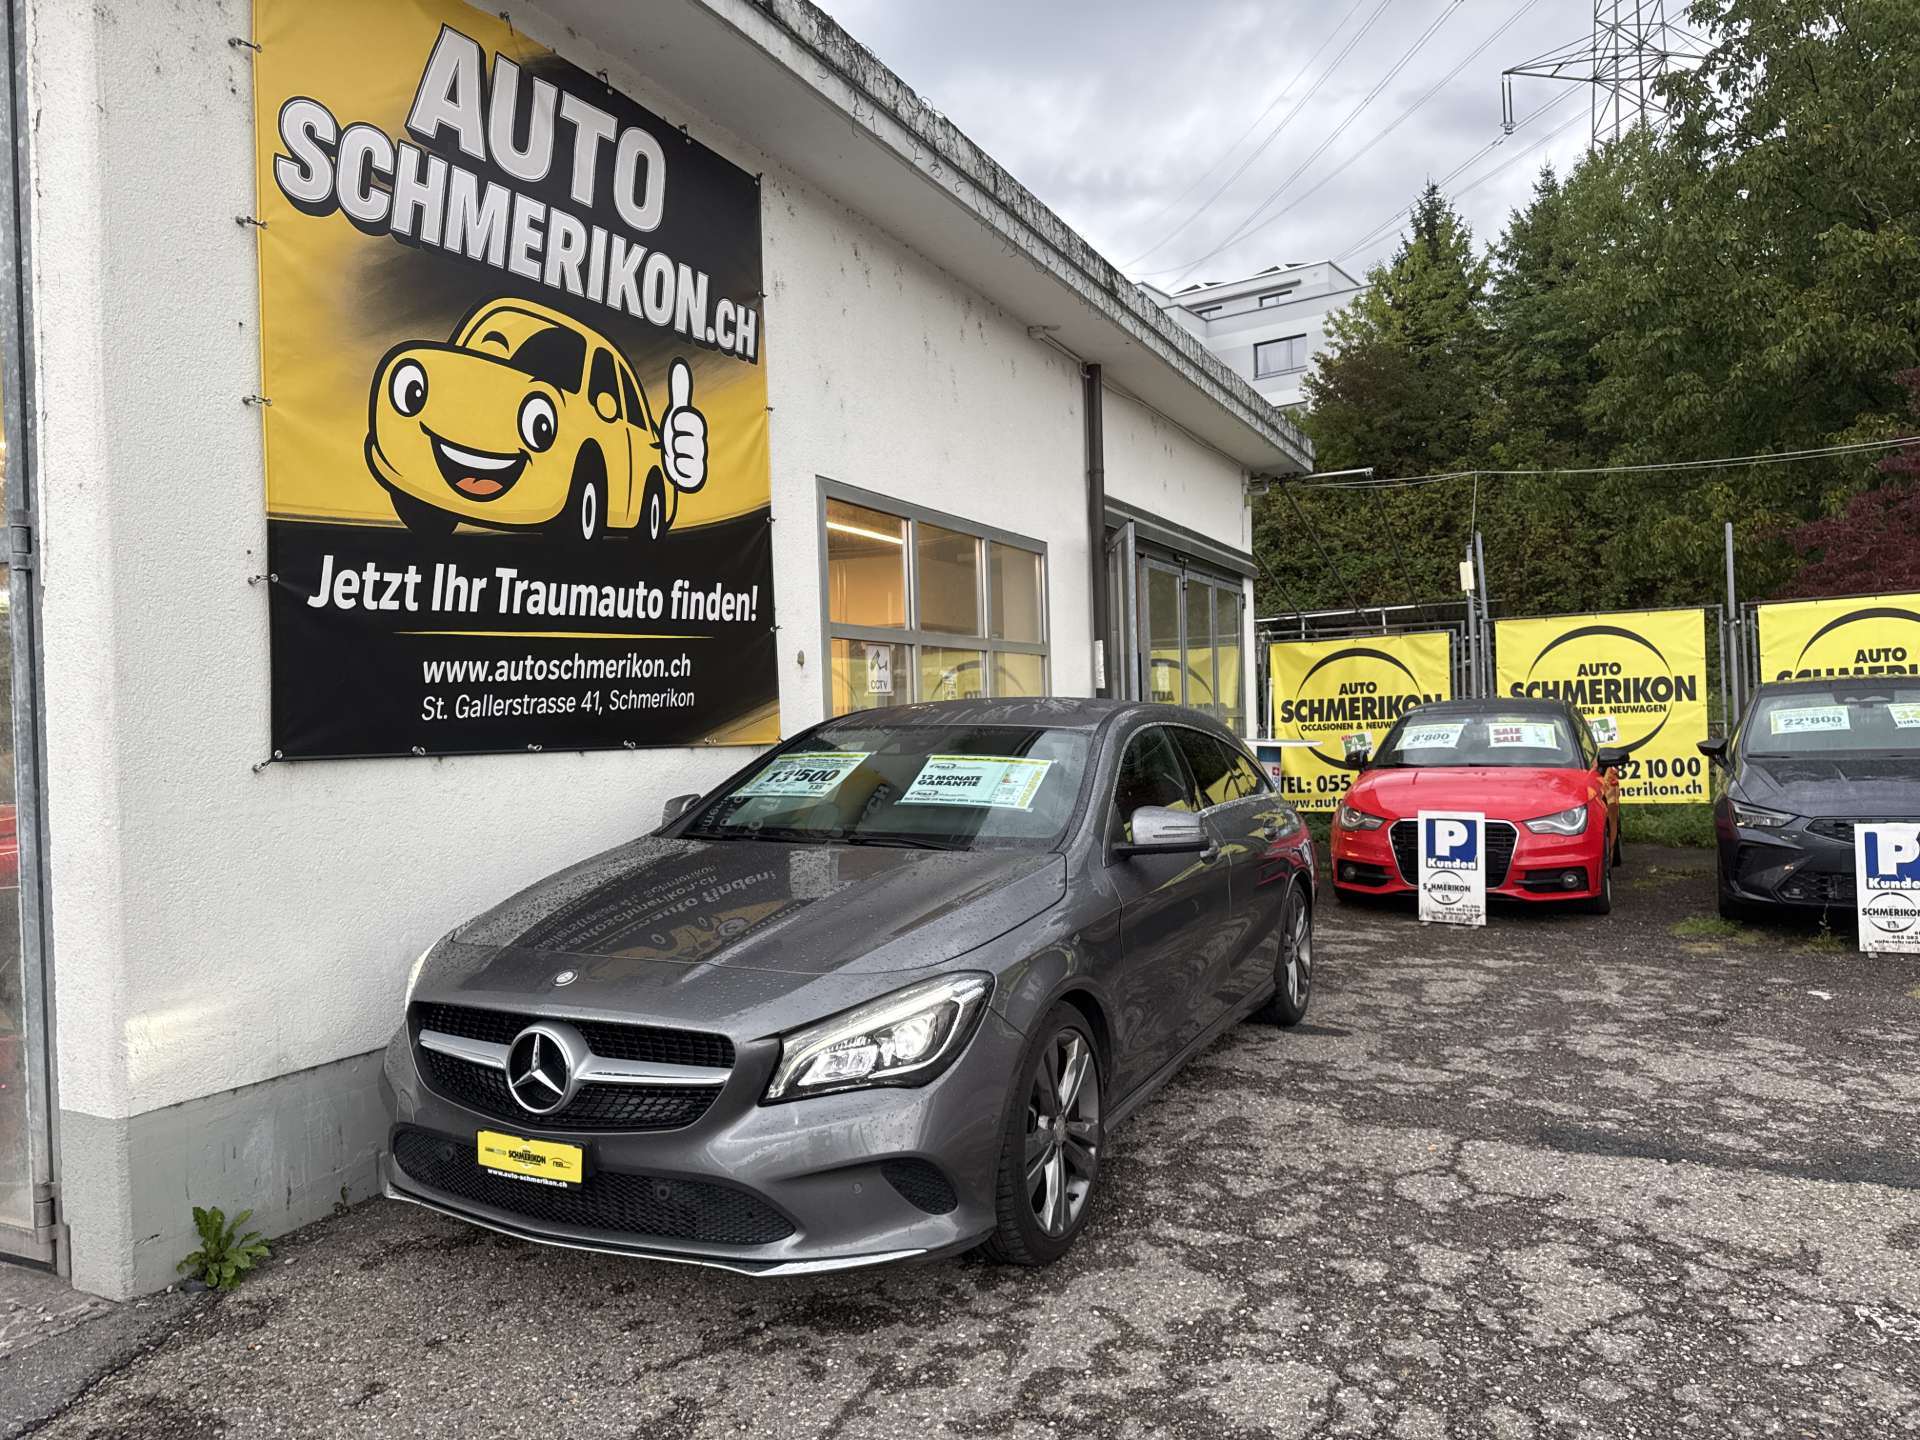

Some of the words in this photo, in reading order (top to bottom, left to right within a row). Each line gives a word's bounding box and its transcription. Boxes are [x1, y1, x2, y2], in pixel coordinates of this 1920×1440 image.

[408, 26, 666, 231] AUTO
[275, 98, 758, 358] SCHMERIKON.CH
[307, 555, 421, 612] Jetzt
[431, 563, 487, 614] Ihr
[495, 567, 664, 620] Traumauto
[671, 580, 759, 622] finden!
[1854, 647, 1907, 664] AUTO
[423, 653, 691, 683] www.autoschmerikon.ch
[1577, 662, 1622, 677] AUTO
[871, 680, 888, 690] CCTV
[1338, 681, 1378, 696] AUTO
[421, 696, 448, 721] St.
[455, 693, 576, 719] Gallerstrasse
[581, 689, 603, 716] 41,
[609, 688, 695, 711] Schmerikon
[1598, 705, 1606, 715] &
[1610, 704, 1667, 714] NEUWAGEN
[1301, 722, 1355, 731] OCCASIONEN
[1356, 722, 1363, 730] &
[1783, 715, 1843, 726] 22'800
[766, 768, 840, 783] 13'500
[917, 779, 980, 787] GARANTIE
[1281, 776, 1312, 793] TEL:
[1316, 774, 1351, 793] 055
[1435, 820, 1468, 857] P
[1427, 857, 1476, 870] Kunden
[508, 1150, 547, 1165] SCHMERIKON
[487, 1168, 568, 1188] www.auto-schmerikon.ch
